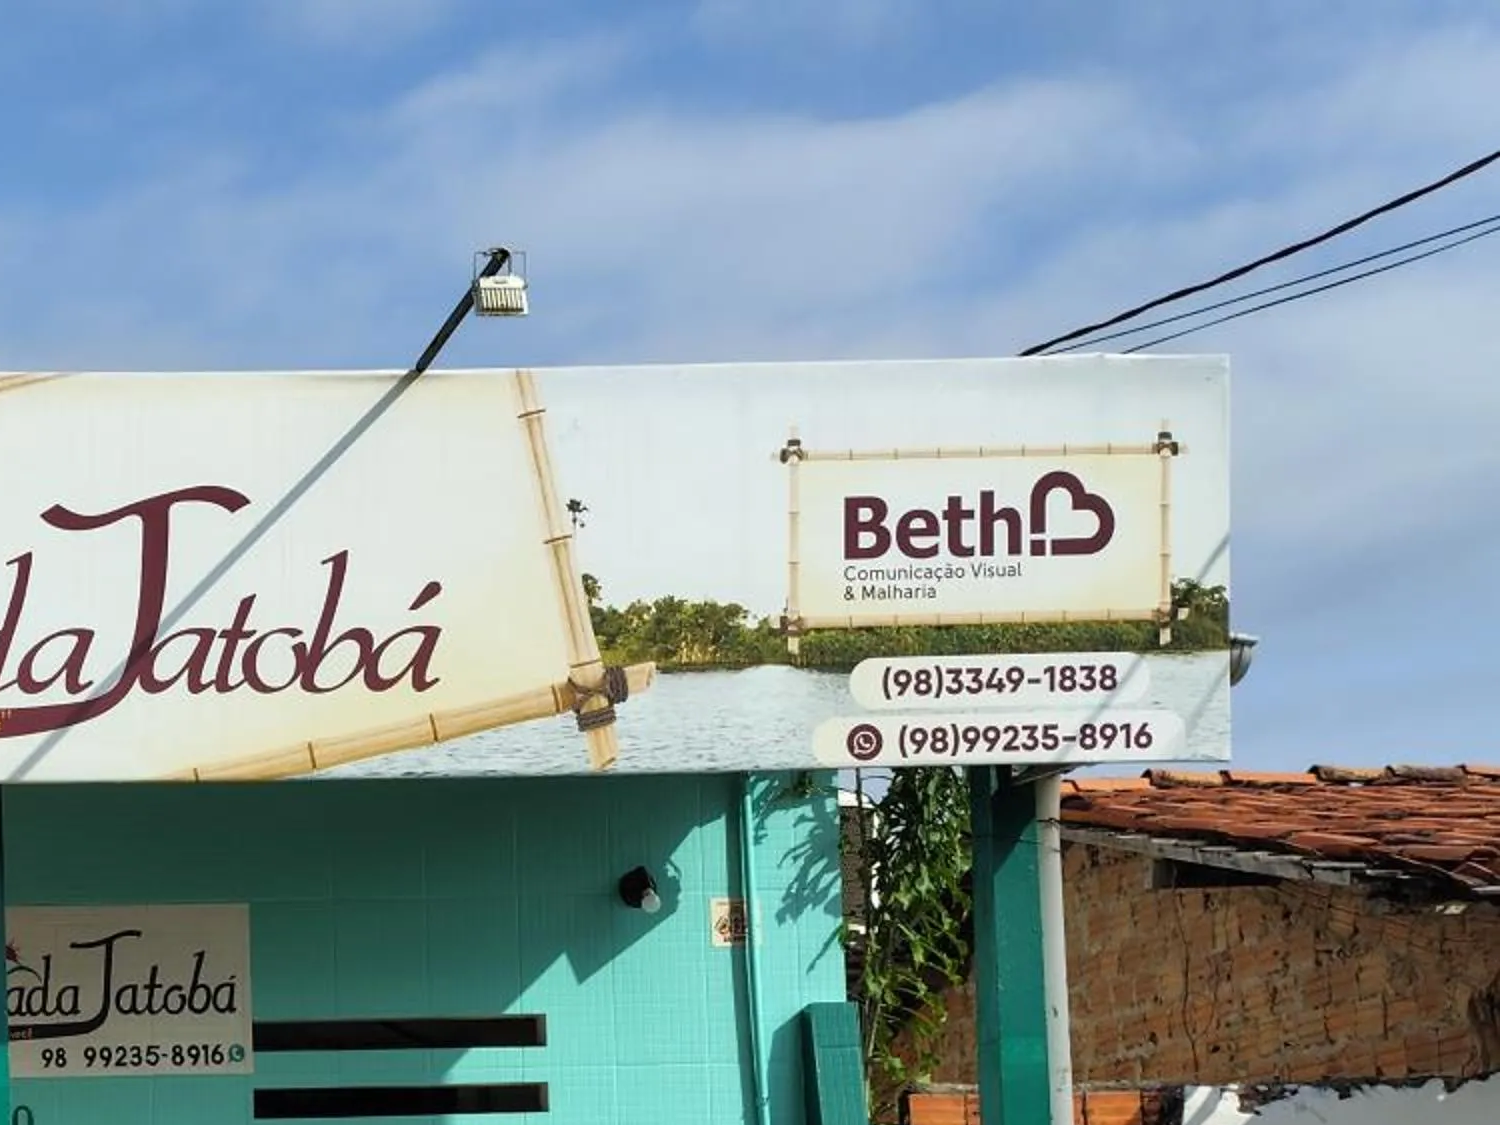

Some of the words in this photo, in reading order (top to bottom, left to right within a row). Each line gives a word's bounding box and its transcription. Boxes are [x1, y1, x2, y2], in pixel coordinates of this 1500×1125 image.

[843, 561, 966, 582] Comunicação
[970, 561, 1022, 578] Visual
[40, 485, 442, 704] Jatobá
[843, 585, 856, 602] &
[861, 583, 938, 601] Malharia
[882, 664, 1118, 700] (98)3349-1838
[899, 722, 1154, 759] (98)99235-8916
[69, 929, 237, 1030] Jatobá
[41, 1048, 67, 1068] 98
[83, 1043, 225, 1068] 99235-8916
